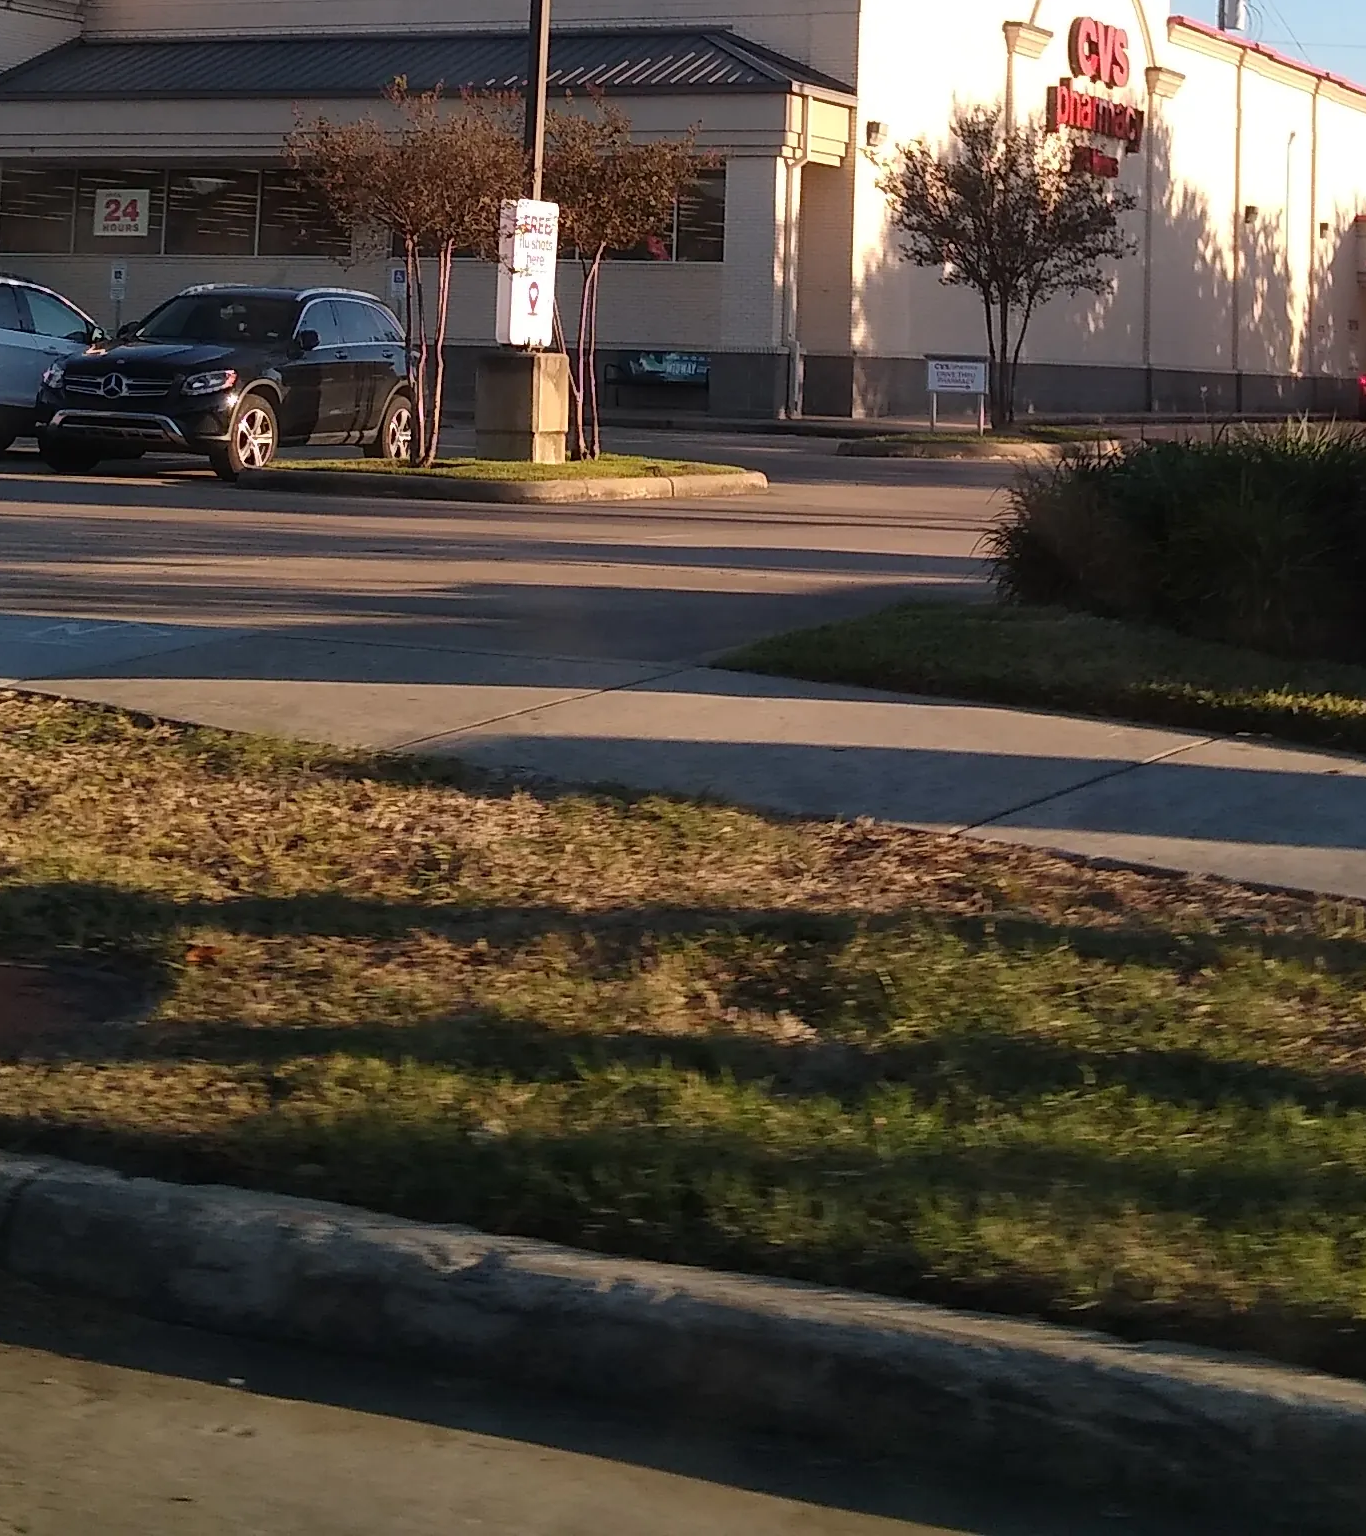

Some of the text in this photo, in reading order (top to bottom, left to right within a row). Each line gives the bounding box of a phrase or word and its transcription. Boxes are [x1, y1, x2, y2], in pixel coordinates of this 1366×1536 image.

[1068, 16, 1129, 88] CVS
[104, 199, 139, 222] 24
[103, 224, 139, 232] HOURS
